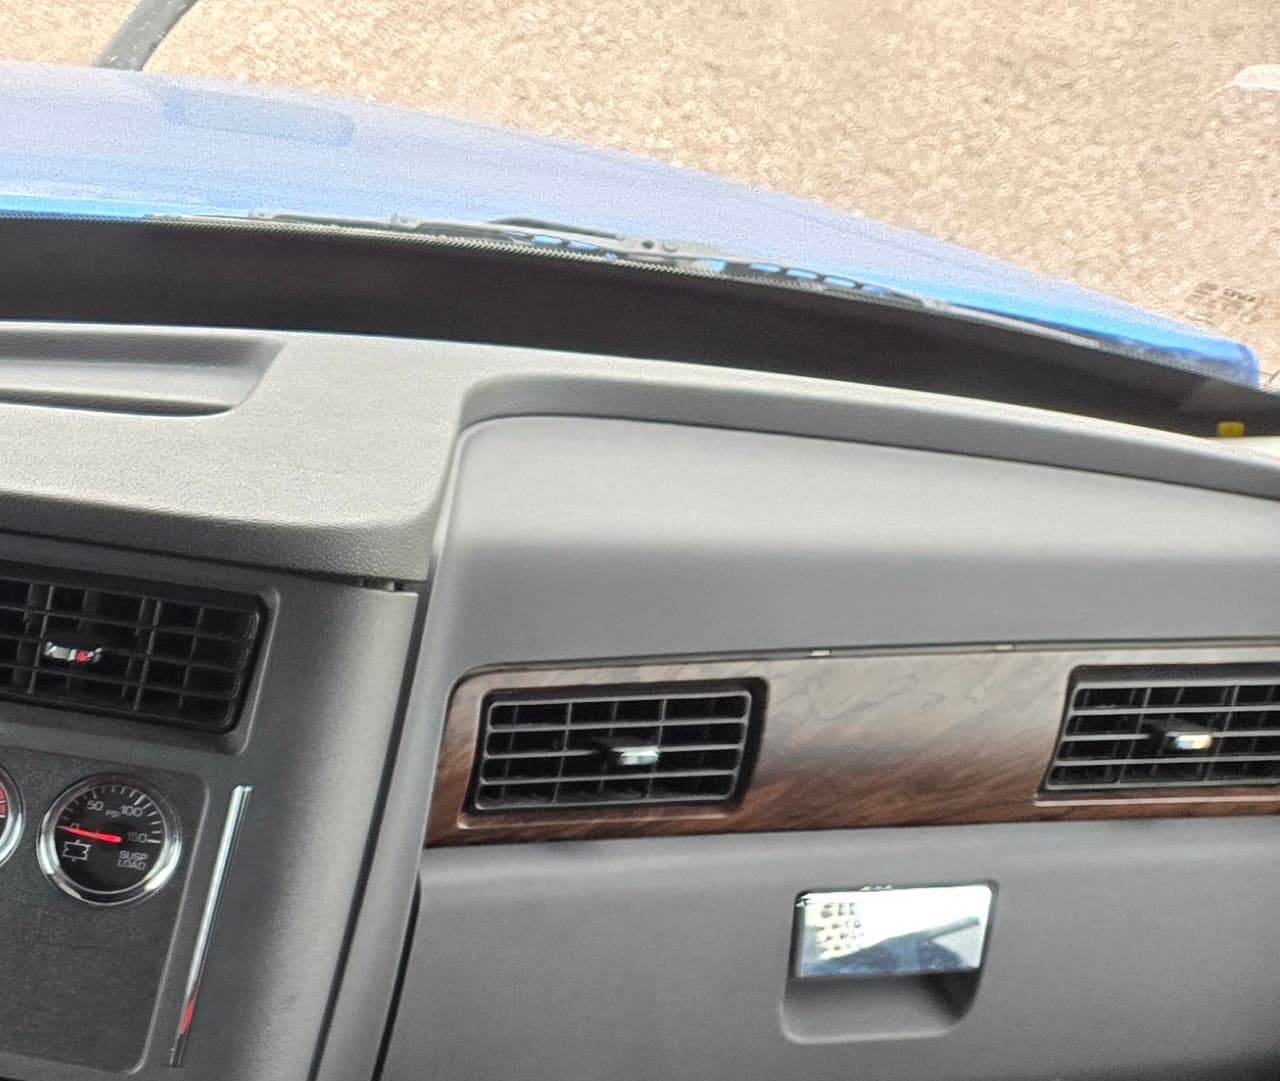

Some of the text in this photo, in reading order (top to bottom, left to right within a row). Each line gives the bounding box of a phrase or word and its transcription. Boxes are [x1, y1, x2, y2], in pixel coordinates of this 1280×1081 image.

[86, 800, 105, 811] 50
[121, 805, 144, 817] 100
[119, 850, 149, 862] SUSP
[117, 859, 147, 871] LOAD
